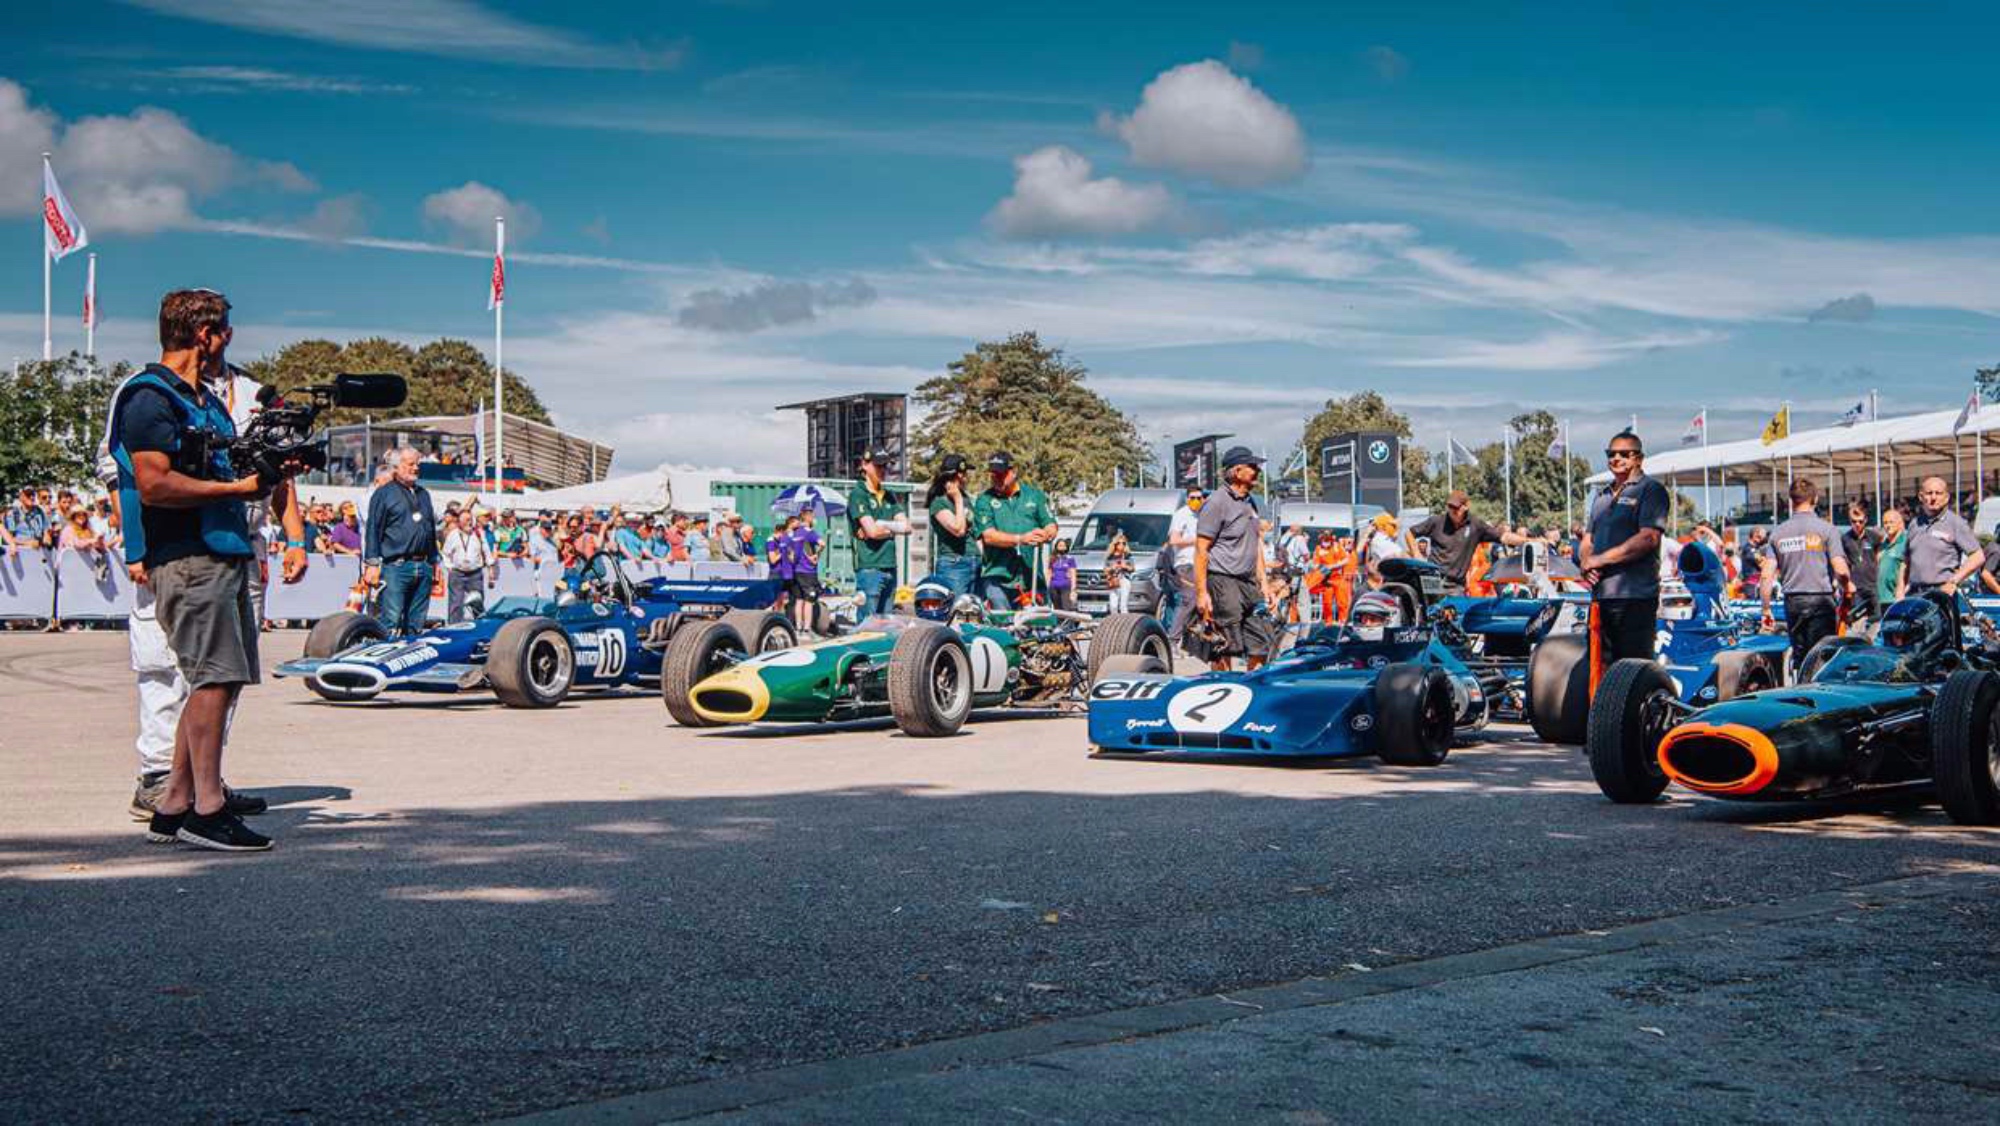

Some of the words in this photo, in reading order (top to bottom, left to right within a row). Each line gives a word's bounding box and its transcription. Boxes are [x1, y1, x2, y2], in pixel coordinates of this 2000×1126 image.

[602, 634, 623, 675] 10
[982, 643, 991, 689] 1
[1092, 681, 1164, 698] elf
[1184, 687, 1231, 723] 2
[1243, 722, 1277, 733] Ford
